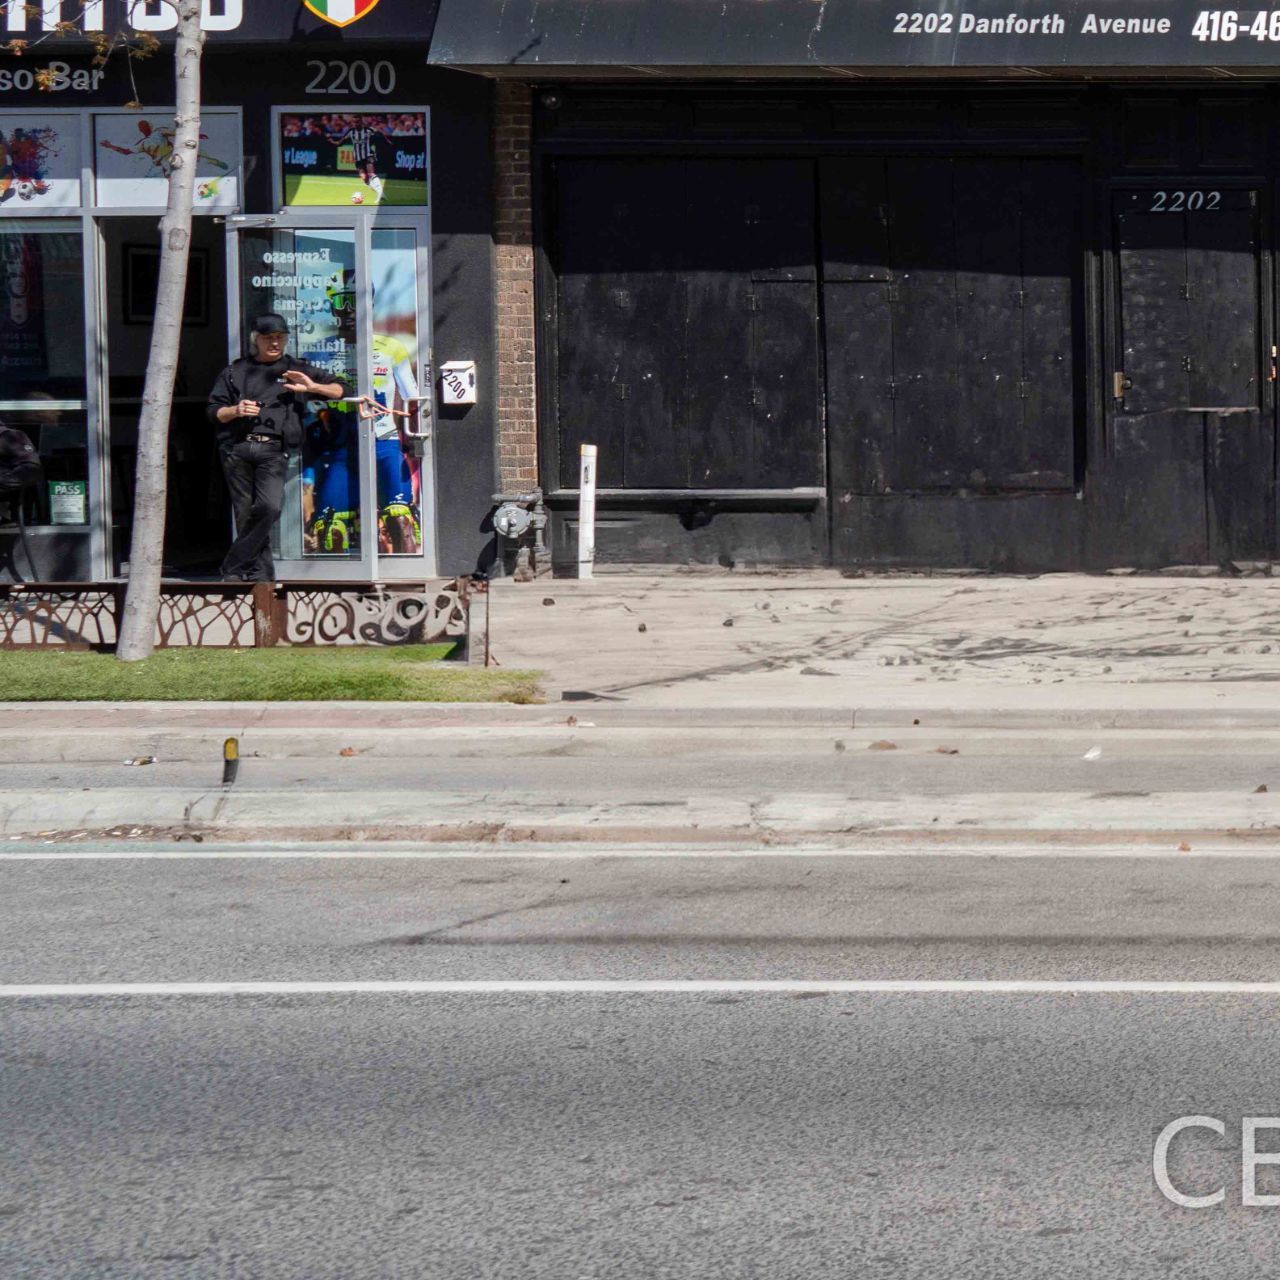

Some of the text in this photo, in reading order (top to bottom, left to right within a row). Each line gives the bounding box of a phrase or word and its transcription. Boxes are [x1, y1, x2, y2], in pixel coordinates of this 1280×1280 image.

[893, 13, 952, 34] 2202
[959, 13, 1065, 34] Danforth
[1081, 15, 1171, 34] Avenue
[48, 61, 105, 91] Bar
[305, 60, 397, 94] 2200
[291, 146, 317, 167] League
[395, 150, 415, 170] Shop
[1150, 191, 1222, 212] 2202
[442, 369, 466, 399] 2200
[55, 485, 80, 495] PASS
